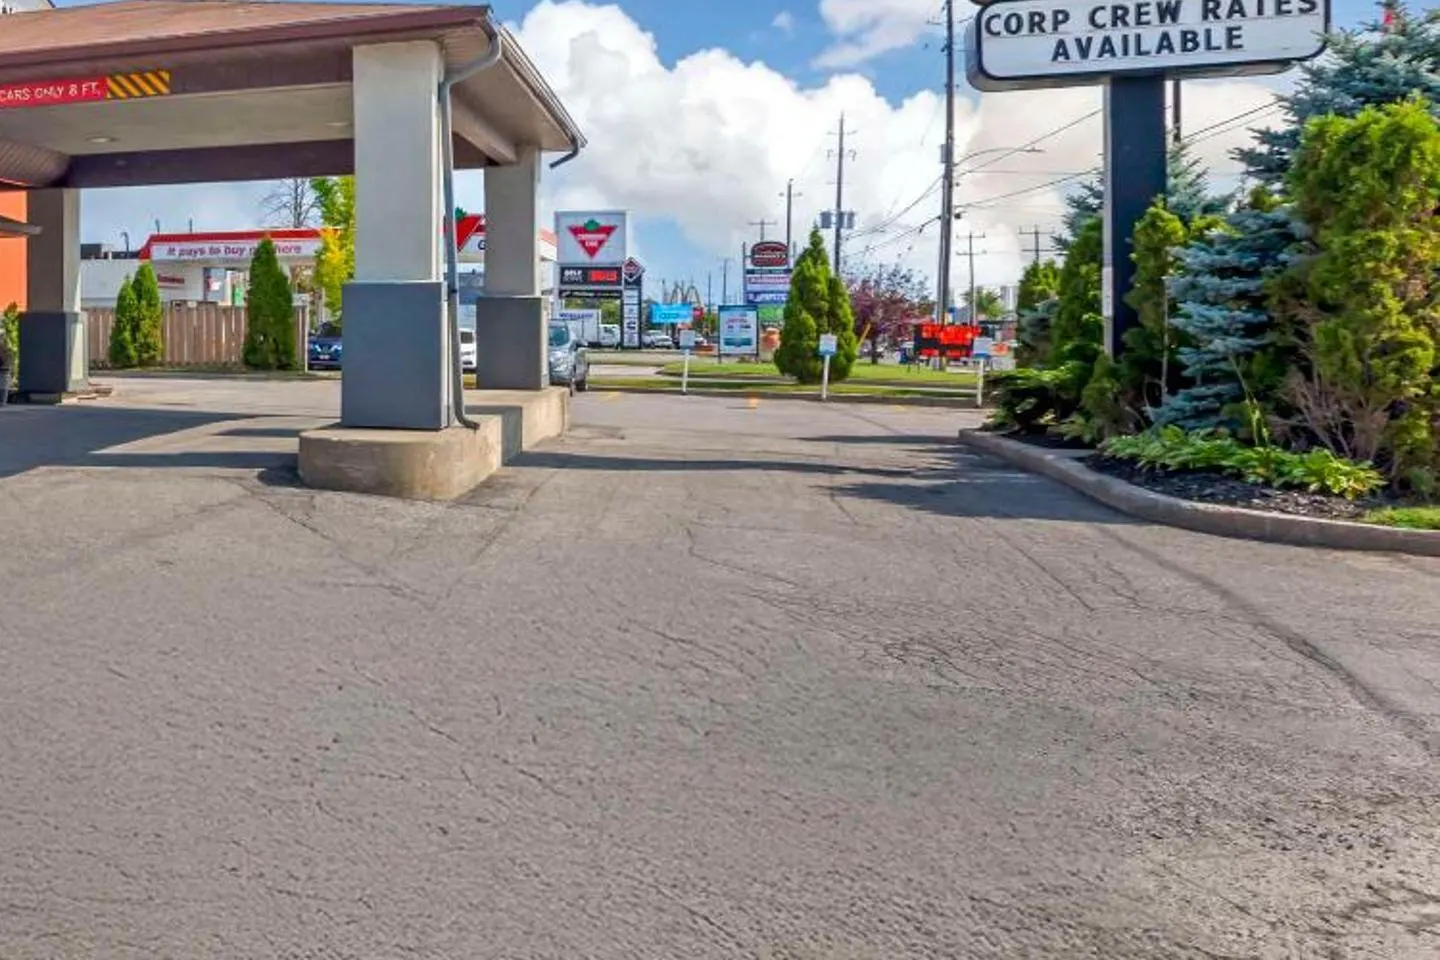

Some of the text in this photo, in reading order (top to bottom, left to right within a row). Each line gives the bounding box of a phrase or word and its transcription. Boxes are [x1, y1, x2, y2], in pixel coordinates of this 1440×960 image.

[984, 9, 1070, 36] CORP
[1088, 0, 1183, 29] CREW
[1051, 26, 1244, 62] AVAILABLE
[34, 85, 65, 99] ONLY
[210, 245, 221, 254] to
[224, 245, 246, 256] buy
